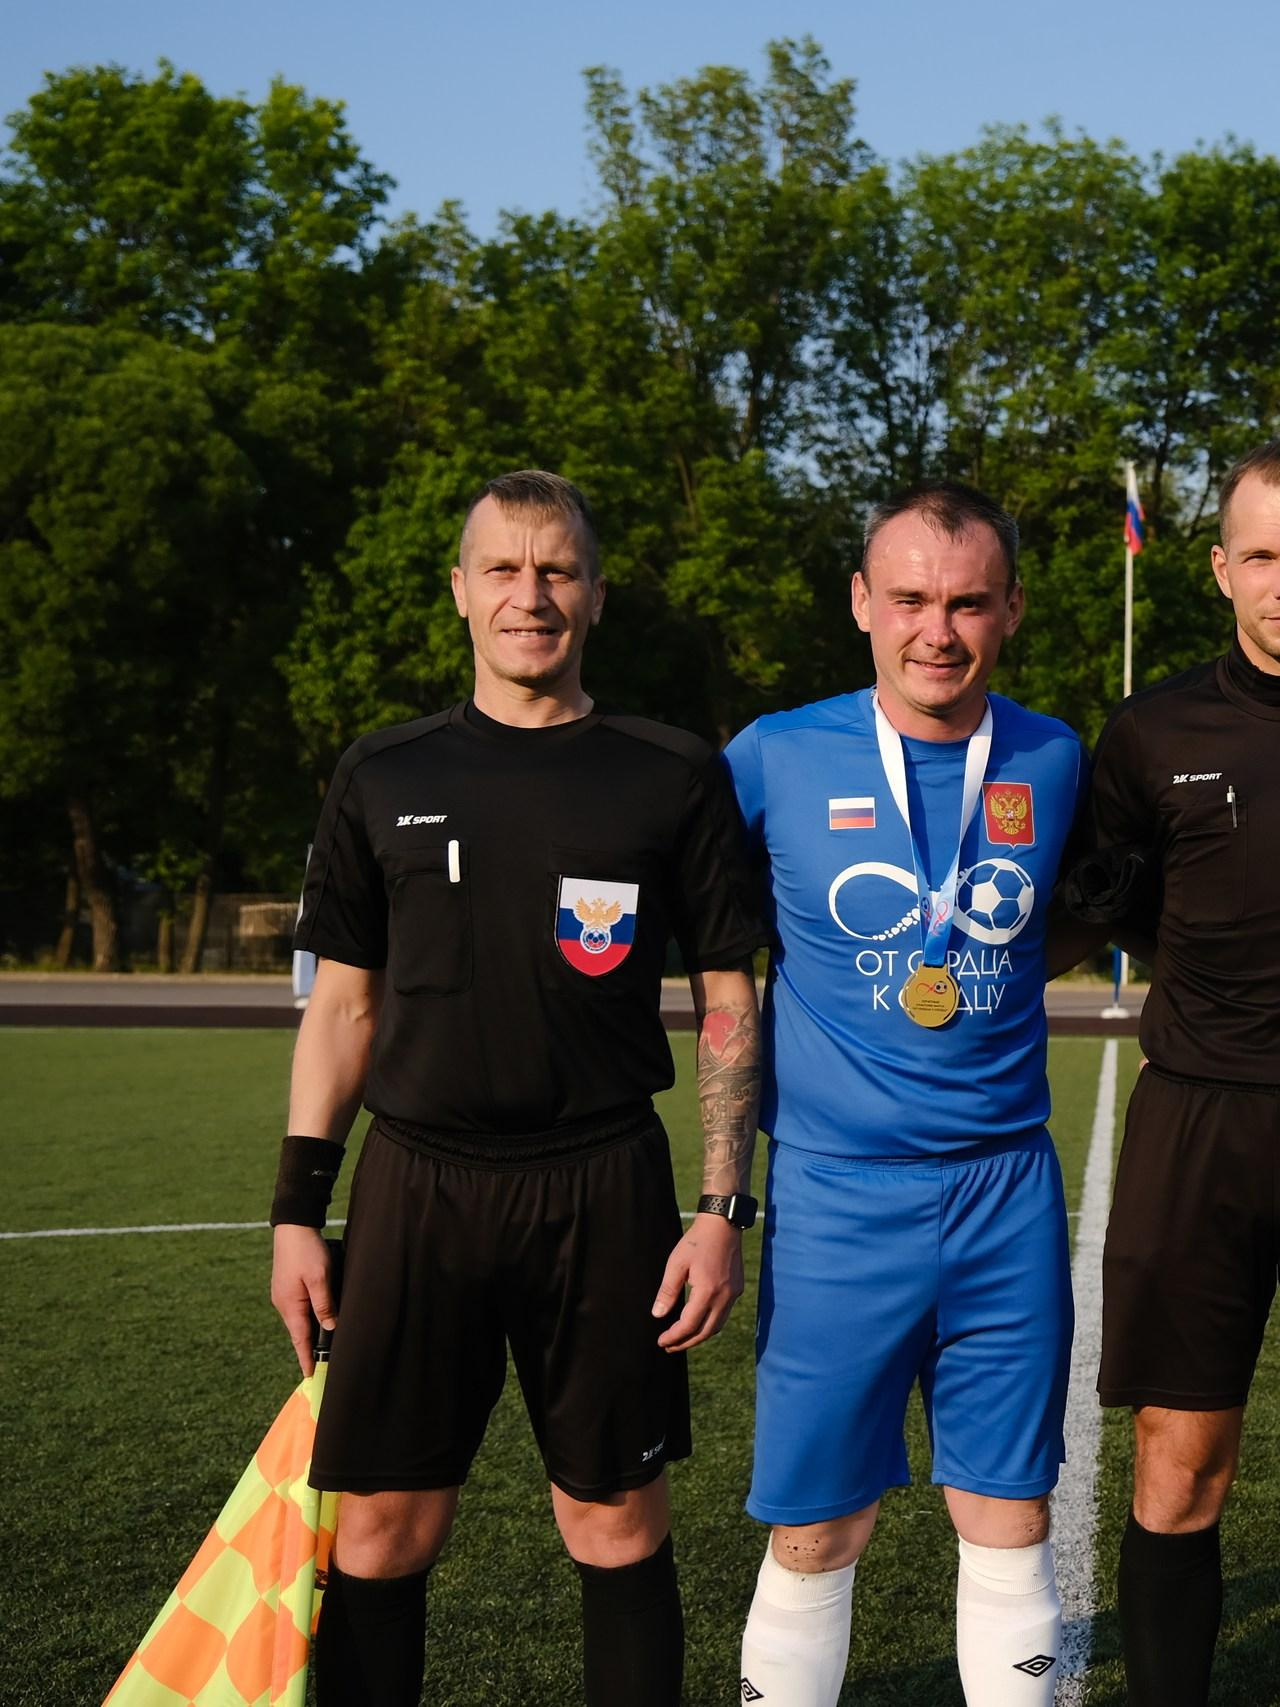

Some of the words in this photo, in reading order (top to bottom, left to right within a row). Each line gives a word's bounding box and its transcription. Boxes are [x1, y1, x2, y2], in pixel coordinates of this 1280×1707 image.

[1172, 773, 1189, 785] 2K
[1189, 772, 1223, 782] SPORT
[396, 815, 414, 827] 2K
[412, 815, 448, 825] SPORT
[855, 950, 899, 977] ОТ
[907, 949, 1013, 980] СРДЦА
[873, 985, 891, 1011] К
